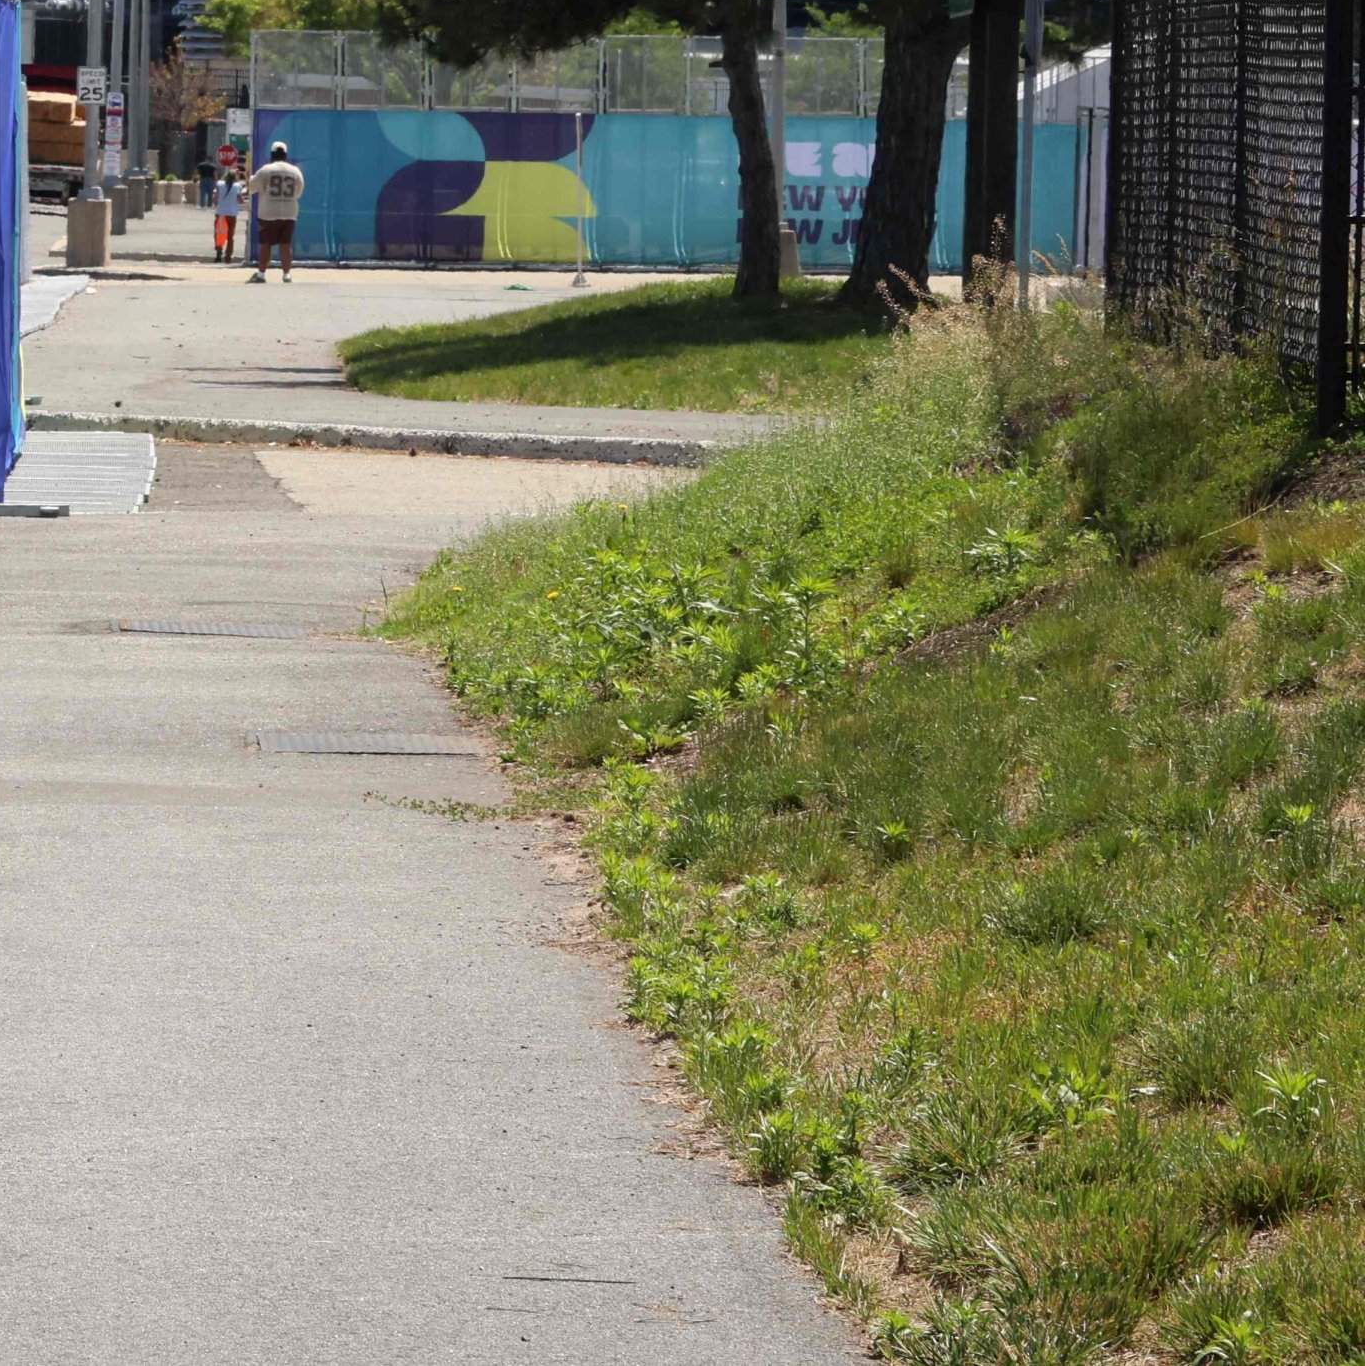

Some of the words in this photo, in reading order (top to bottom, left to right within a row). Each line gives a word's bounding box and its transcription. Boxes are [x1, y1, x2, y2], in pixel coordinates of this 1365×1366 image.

[79, 87, 103, 101] 25
[219, 151, 236, 159] STOP
[270, 175, 295, 198] 93
